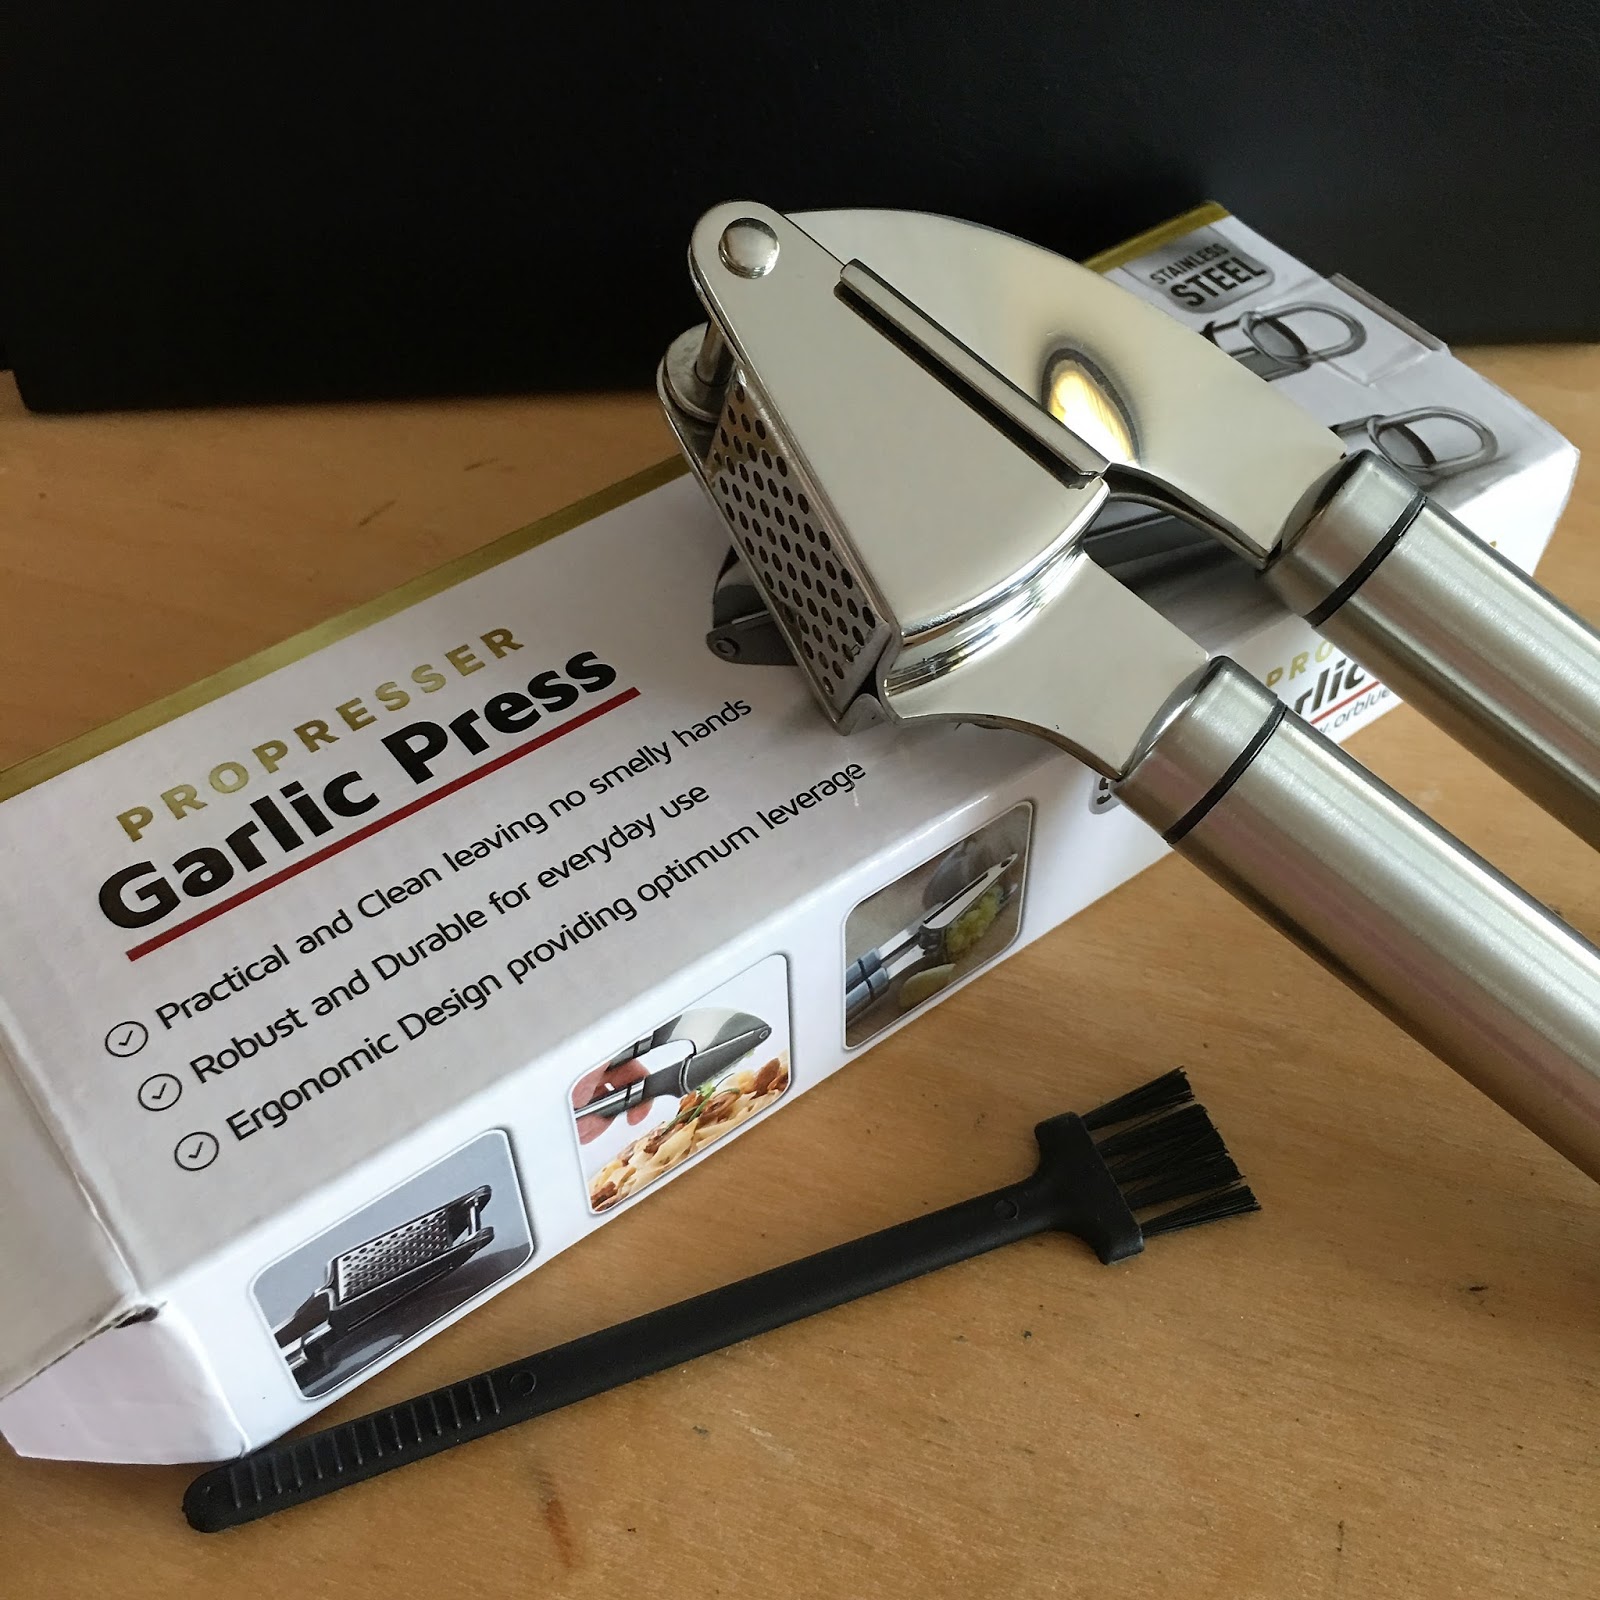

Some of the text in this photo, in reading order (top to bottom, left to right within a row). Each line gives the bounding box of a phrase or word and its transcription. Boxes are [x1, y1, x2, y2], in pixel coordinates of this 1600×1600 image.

[1150, 243, 1229, 285] STAINLESS
[1170, 256, 1267, 307] STEEL
[98, 651, 617, 929] Garlic Press
[116, 627, 524, 843] PROPRESSER
[1294, 658, 1366, 715] rlic
[155, 699, 752, 1030] Practical and Clean leaving no smelly hands
[189, 786, 710, 1085] Robust and Durable for everyday use
[224, 763, 867, 1142] Ergonomic Design providing optimum leverage
